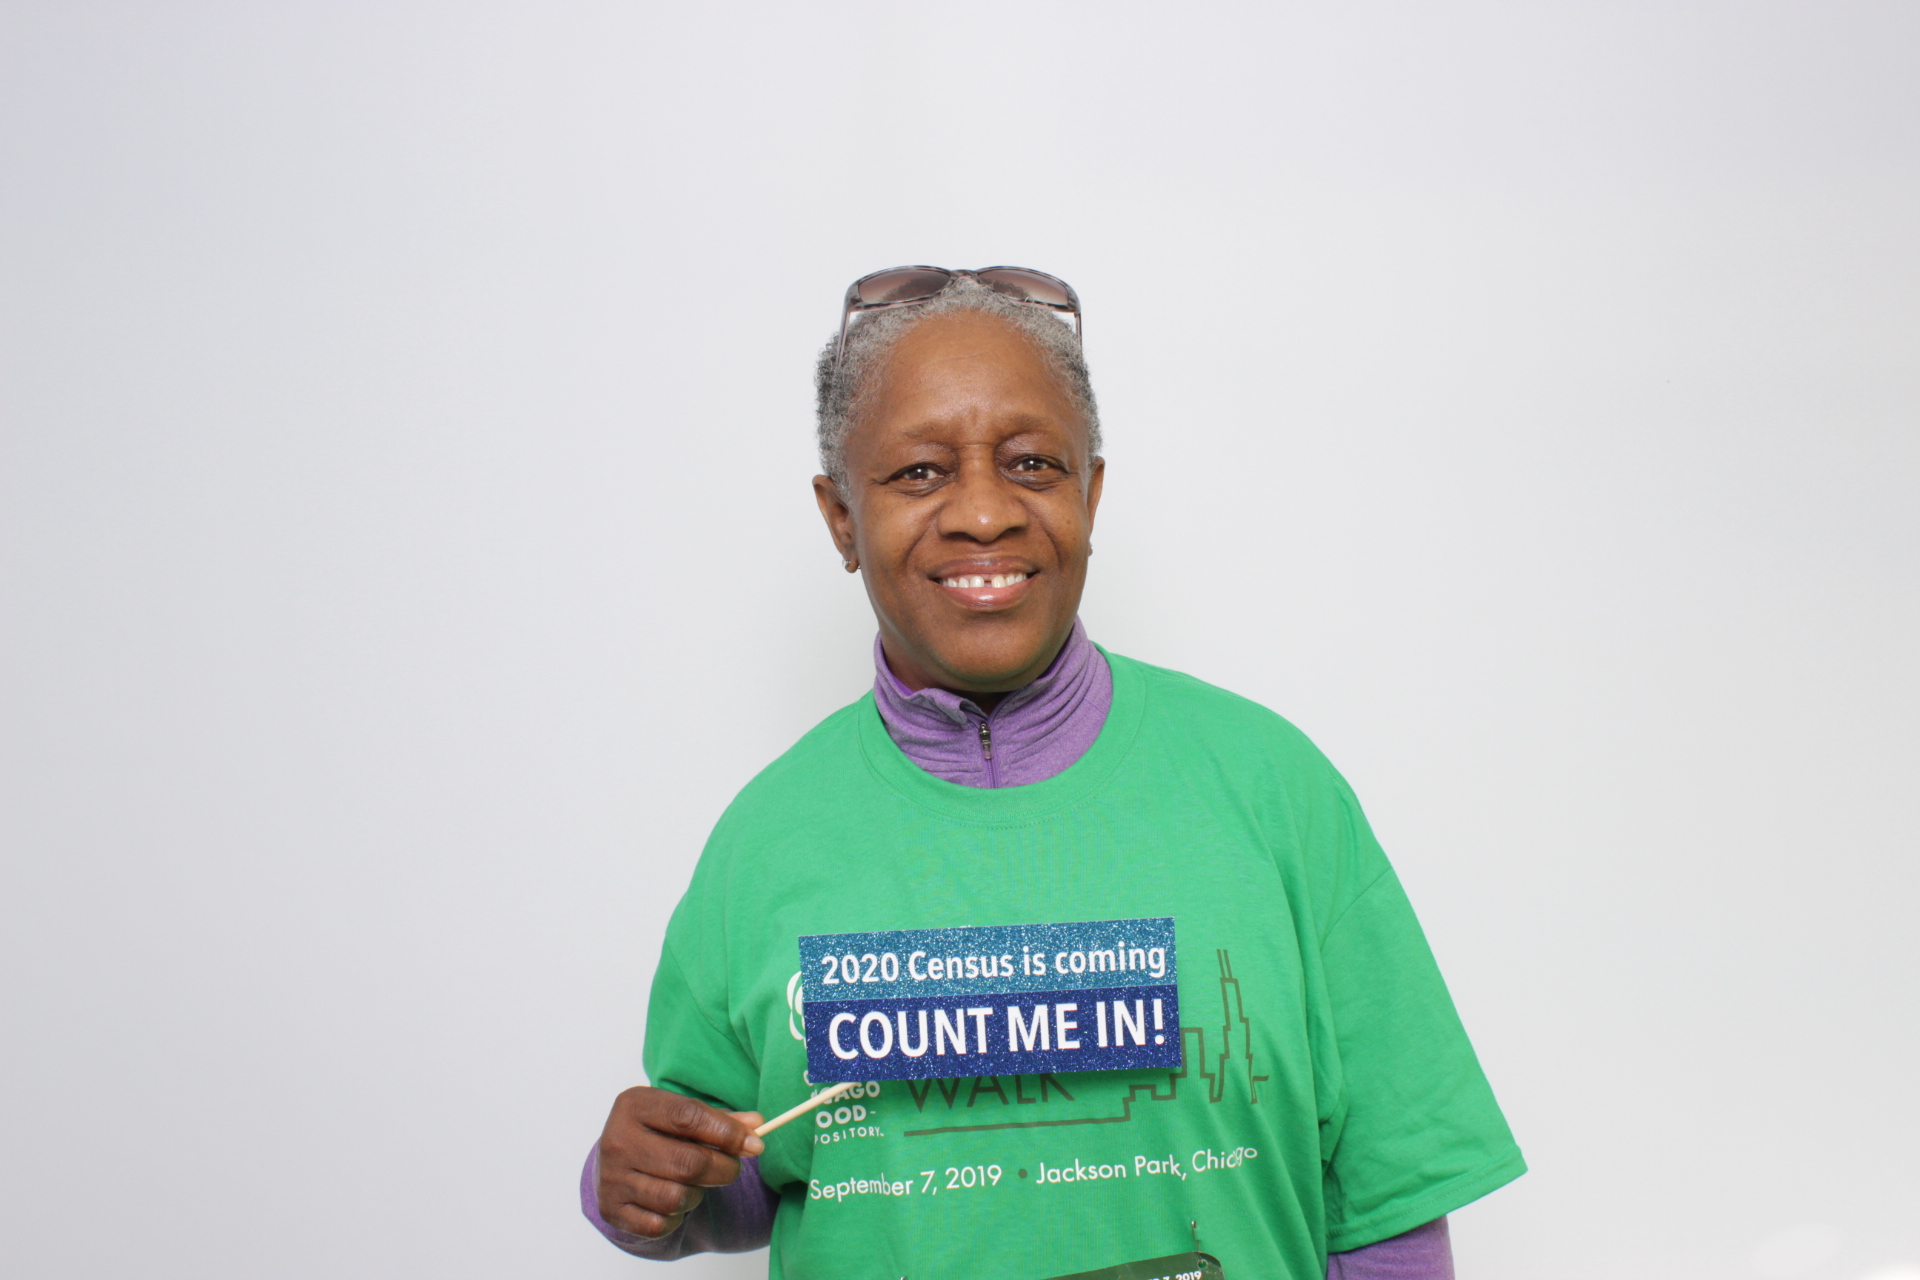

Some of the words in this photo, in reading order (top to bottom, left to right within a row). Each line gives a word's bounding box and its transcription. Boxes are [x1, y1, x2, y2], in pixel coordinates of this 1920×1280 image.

[821, 952, 899, 985] 2020
[908, 950, 1014, 981] Census
[1022, 945, 1047, 976] is
[1055, 940, 1166, 979] coming
[828, 1007, 994, 1060] COUNT
[1007, 1003, 1081, 1052] ME
[1096, 998, 1165, 1048] IN!
[906, 1073, 1076, 1113] WALK
[810, 1172, 914, 1203] September
[919, 1169, 938, 1196] 7,
[945, 1164, 1003, 1190] 2019
[1036, 1158, 1127, 1184] Jackson
[1134, 1153, 1187, 1181] Park,
[1191, 1146, 1258, 1172] Chicgo
